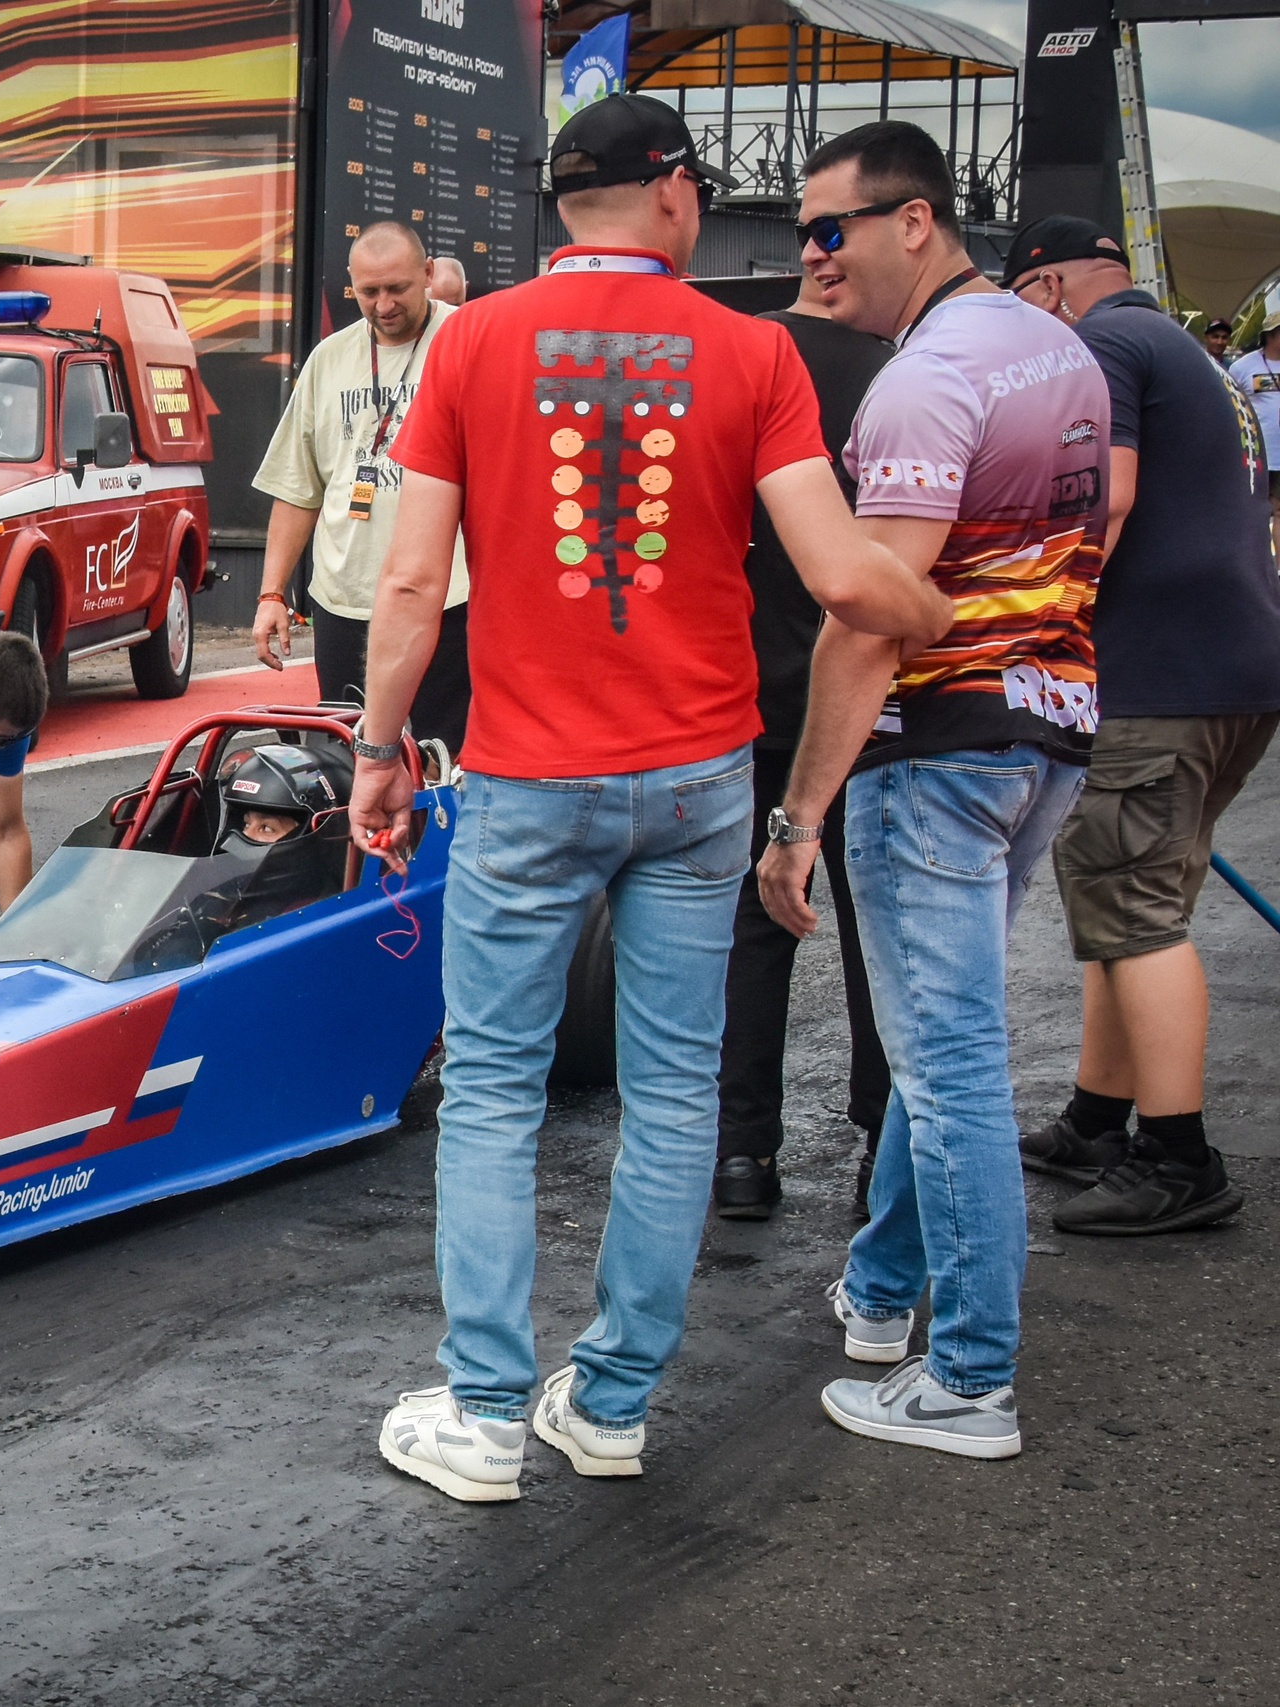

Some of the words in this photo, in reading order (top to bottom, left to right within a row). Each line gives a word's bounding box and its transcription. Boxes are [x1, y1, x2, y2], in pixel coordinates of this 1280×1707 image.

[1045, 34, 1091, 46] АВТО
[1041, 46, 1074, 55] ПЛЮС
[168, 418, 184, 437] TEAM
[99, 475, 124, 490] МОСКВА
[85, 543, 107, 593] FC
[83, 596, 124, 611] Fire-Center.ru
[595, 1429, 639, 1441] Reebok
